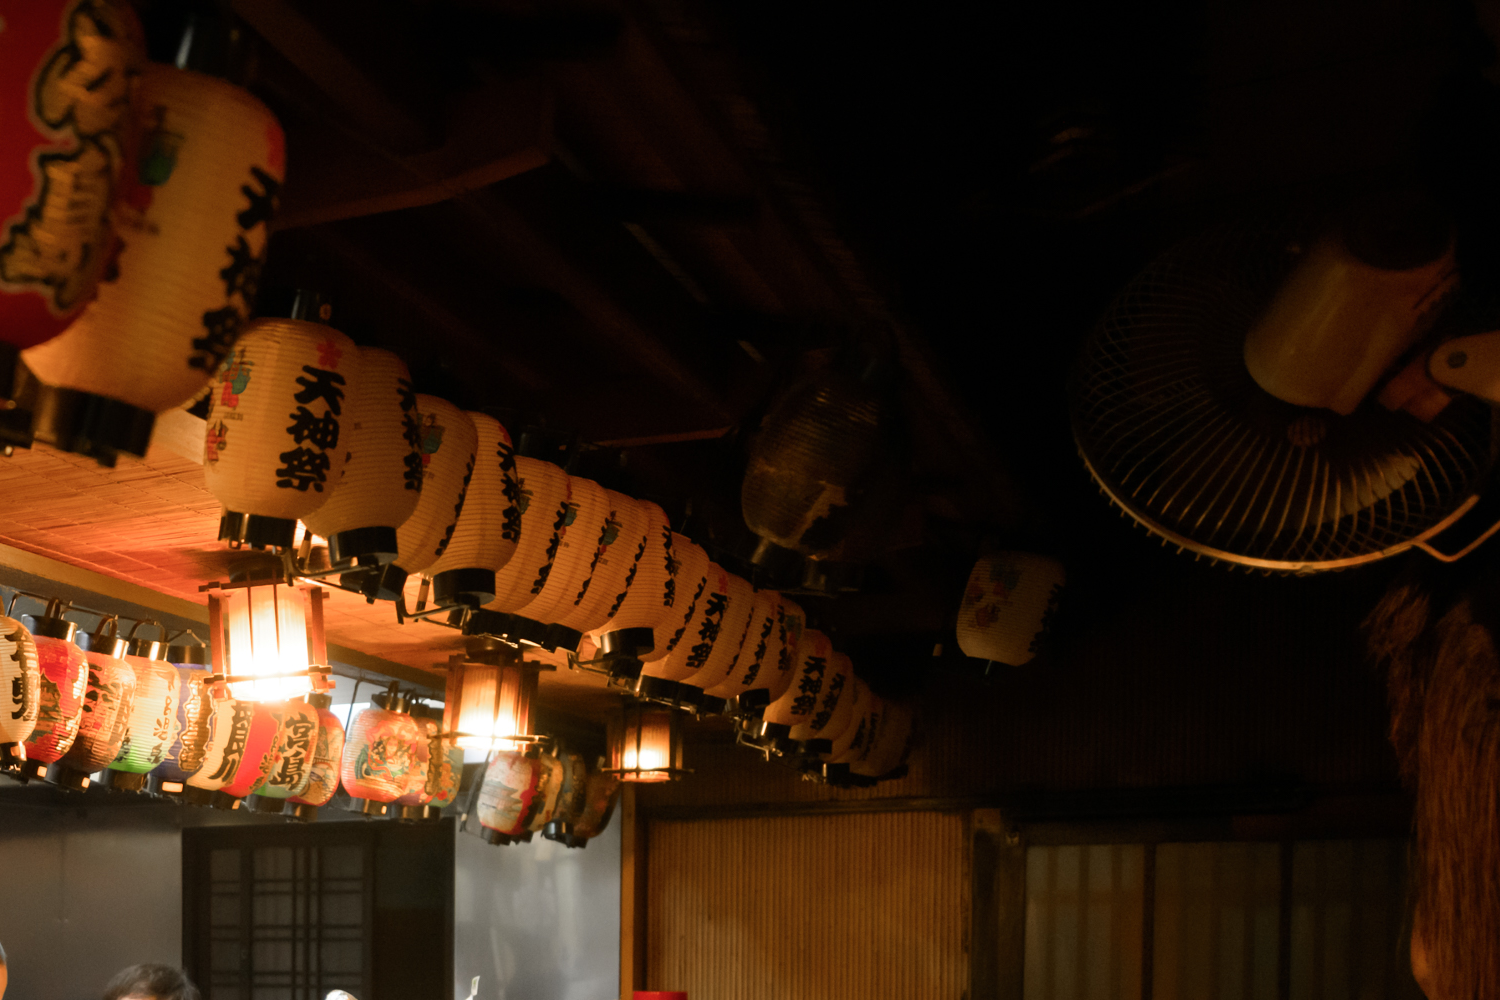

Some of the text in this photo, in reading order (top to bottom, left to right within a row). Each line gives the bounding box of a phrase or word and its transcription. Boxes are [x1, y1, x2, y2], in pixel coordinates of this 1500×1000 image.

[275, 364, 346, 493] 天神祭
[686, 592, 728, 668] 天神祭
[790, 655, 827, 716] 天神祭
[268, 712, 316, 791] 宮島
